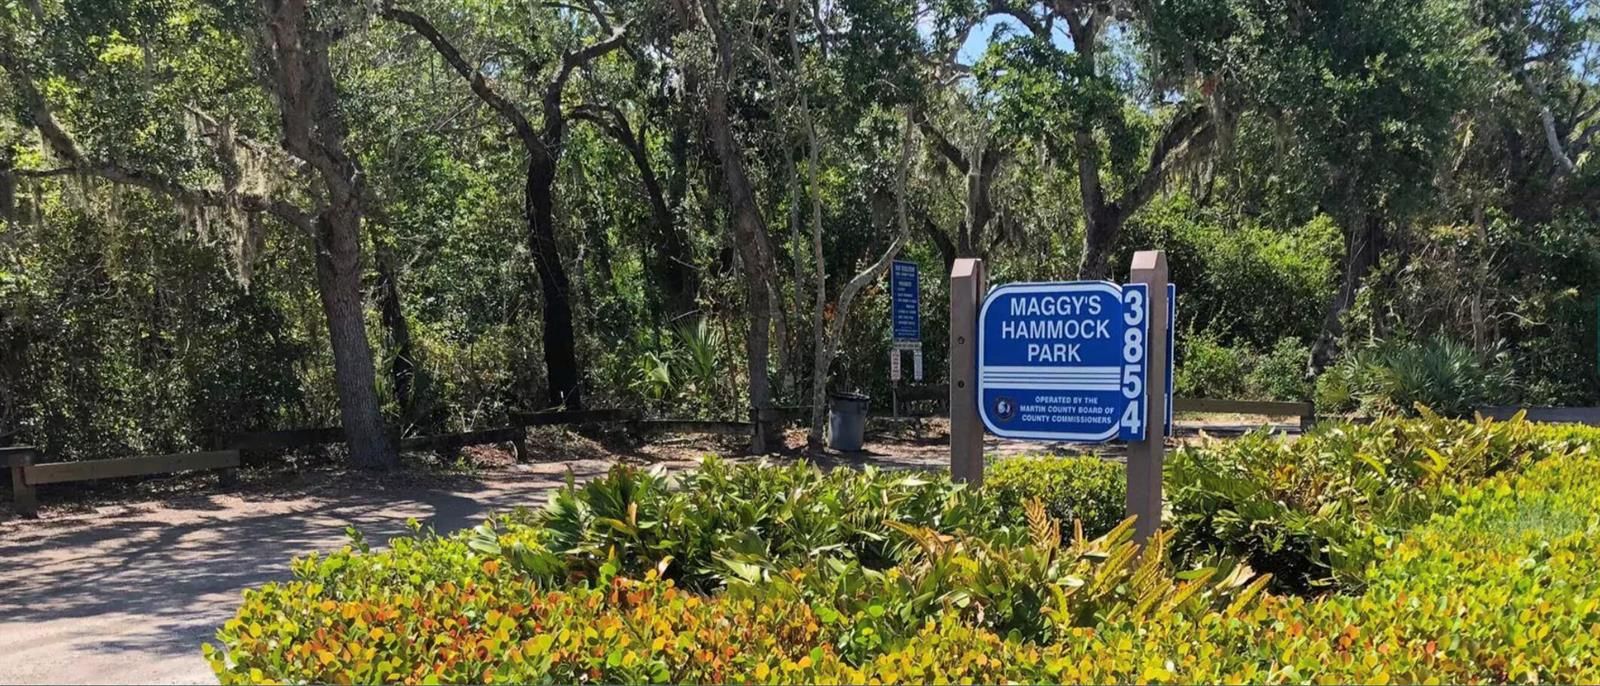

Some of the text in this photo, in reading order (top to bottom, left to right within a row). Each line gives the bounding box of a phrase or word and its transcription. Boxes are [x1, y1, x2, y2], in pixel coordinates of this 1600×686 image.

[1010, 295, 1102, 316] MAGGY'S
[1002, 319, 1111, 339] HAMMOCK
[1027, 343, 1082, 362] PARK
[1121, 290, 1143, 434] 3854
[1020, 404, 1115, 414] MARTIN COUNTY BOARD OF
[1035, 396, 1071, 404] OPERATED
[1073, 396, 1083, 404] BY
[1021, 414, 1112, 424] COUNTY COMMISSIONERS
